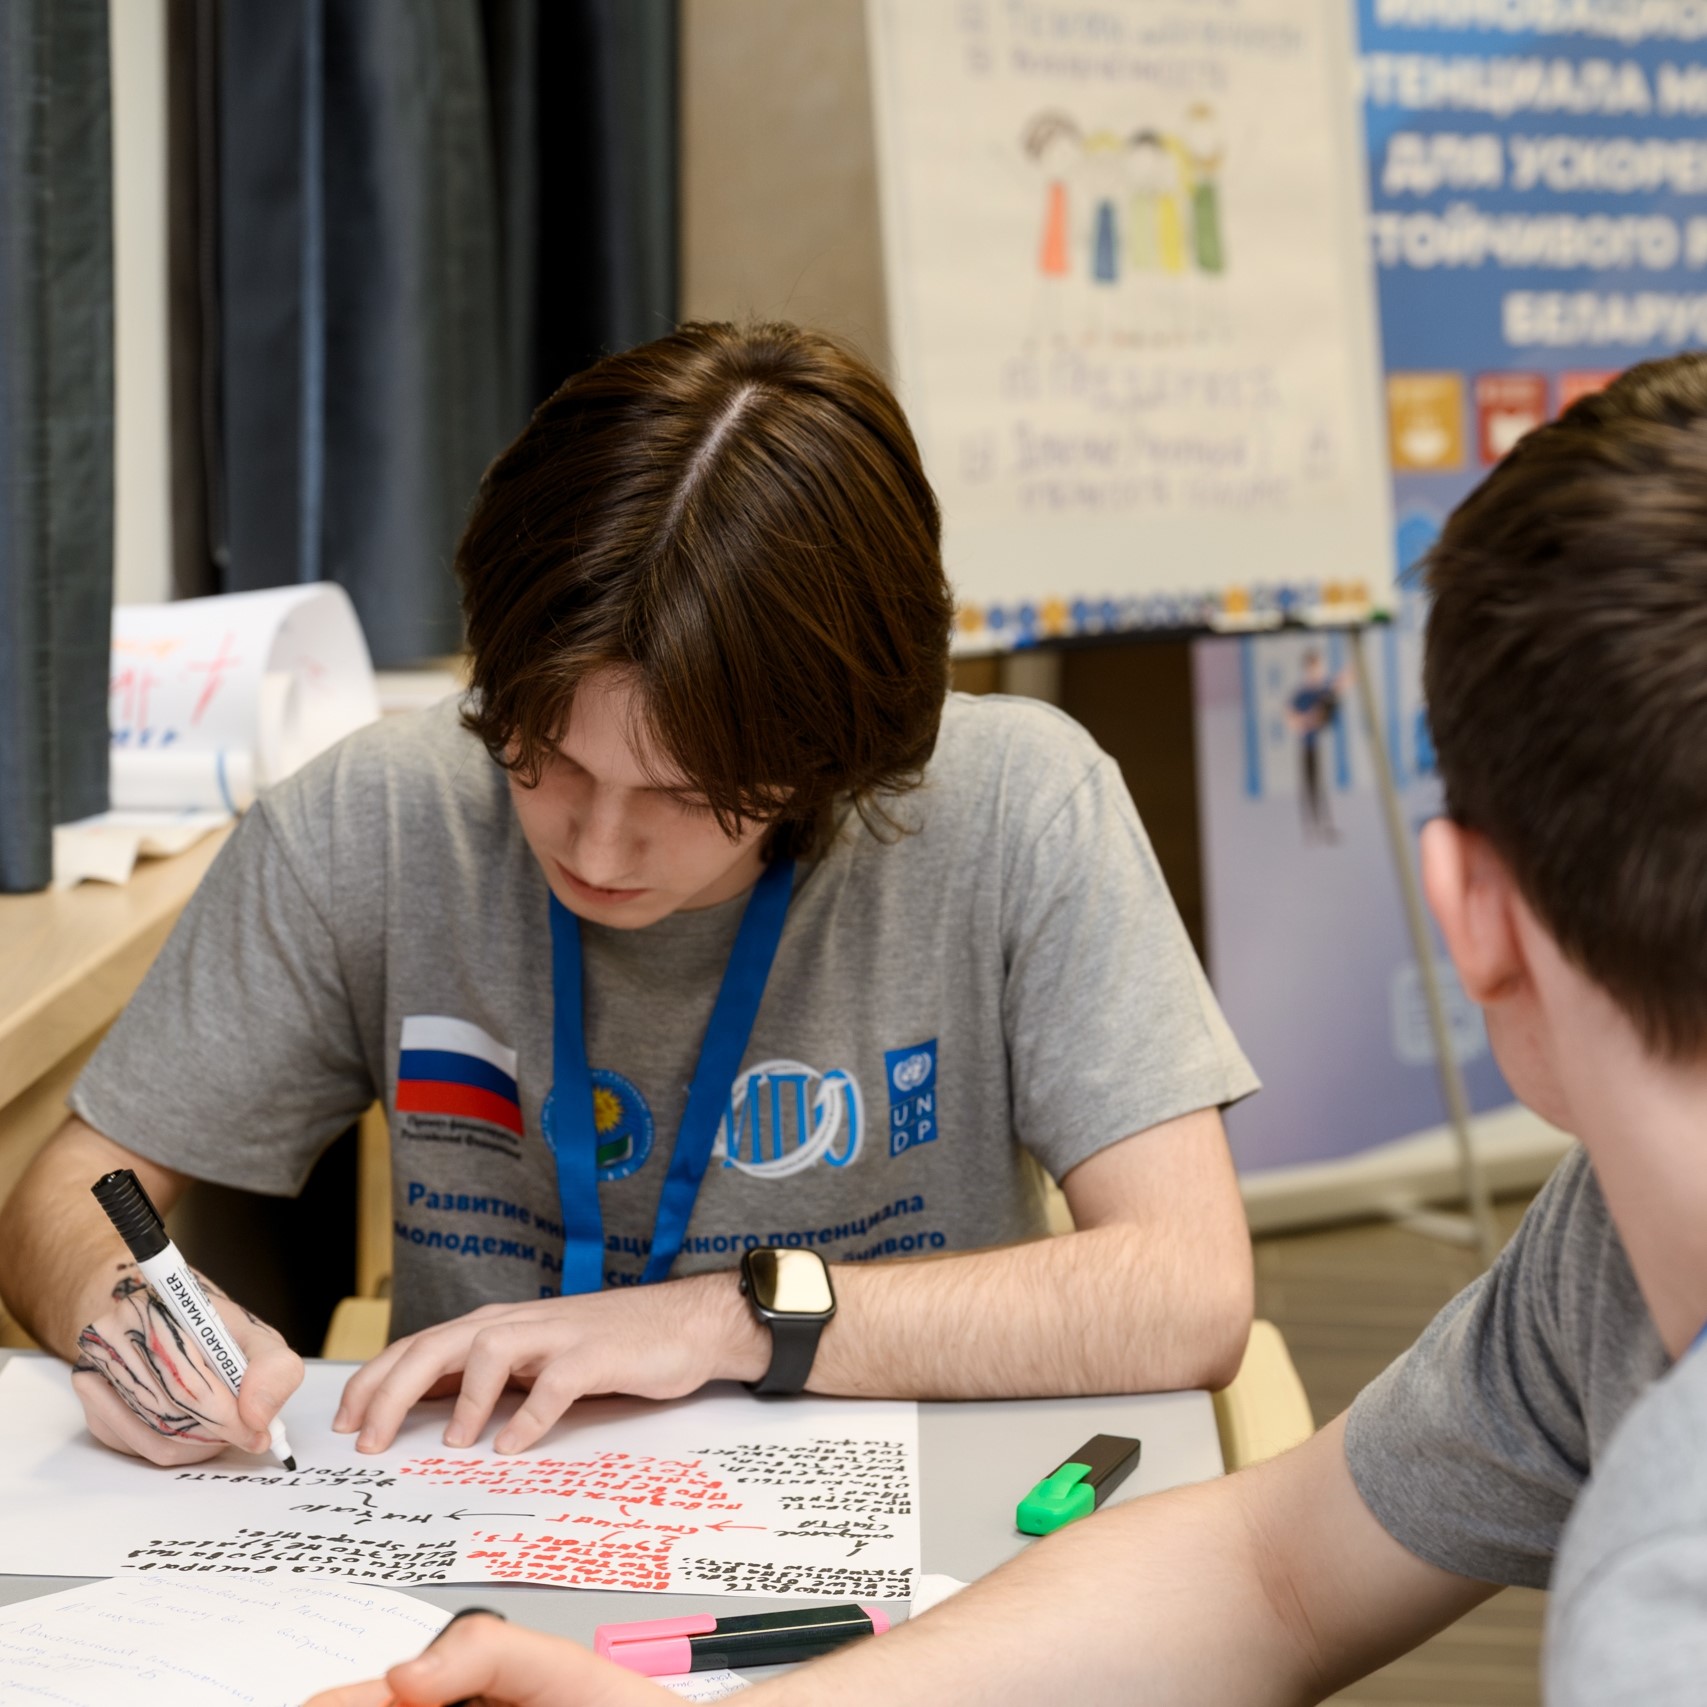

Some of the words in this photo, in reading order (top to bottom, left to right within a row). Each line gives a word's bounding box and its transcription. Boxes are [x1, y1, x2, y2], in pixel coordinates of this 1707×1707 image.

[1362, 52, 1654, 119] ТЕНЦИАЛА
[1382, 132, 1503, 196] ДЛЯ
[1374, 203, 1681, 269] ТОЙЧИВОГО
[408, 1182, 531, 1224] Развитие
[166, 1273, 206, 1327] MARKER
[797, 1520, 889, 1531] старта
[149, 1539, 281, 1549] удалось
[284, 1542, 322, 1551] не
[128, 1549, 360, 1564] оборудования
[328, 1547, 382, 1559] это
[392, 1551, 458, 1562] если
[369, 1558, 456, 1570] ности
[291, 1566, 446, 1583] убедиться
[491, 1571, 670, 1590] внимательно
